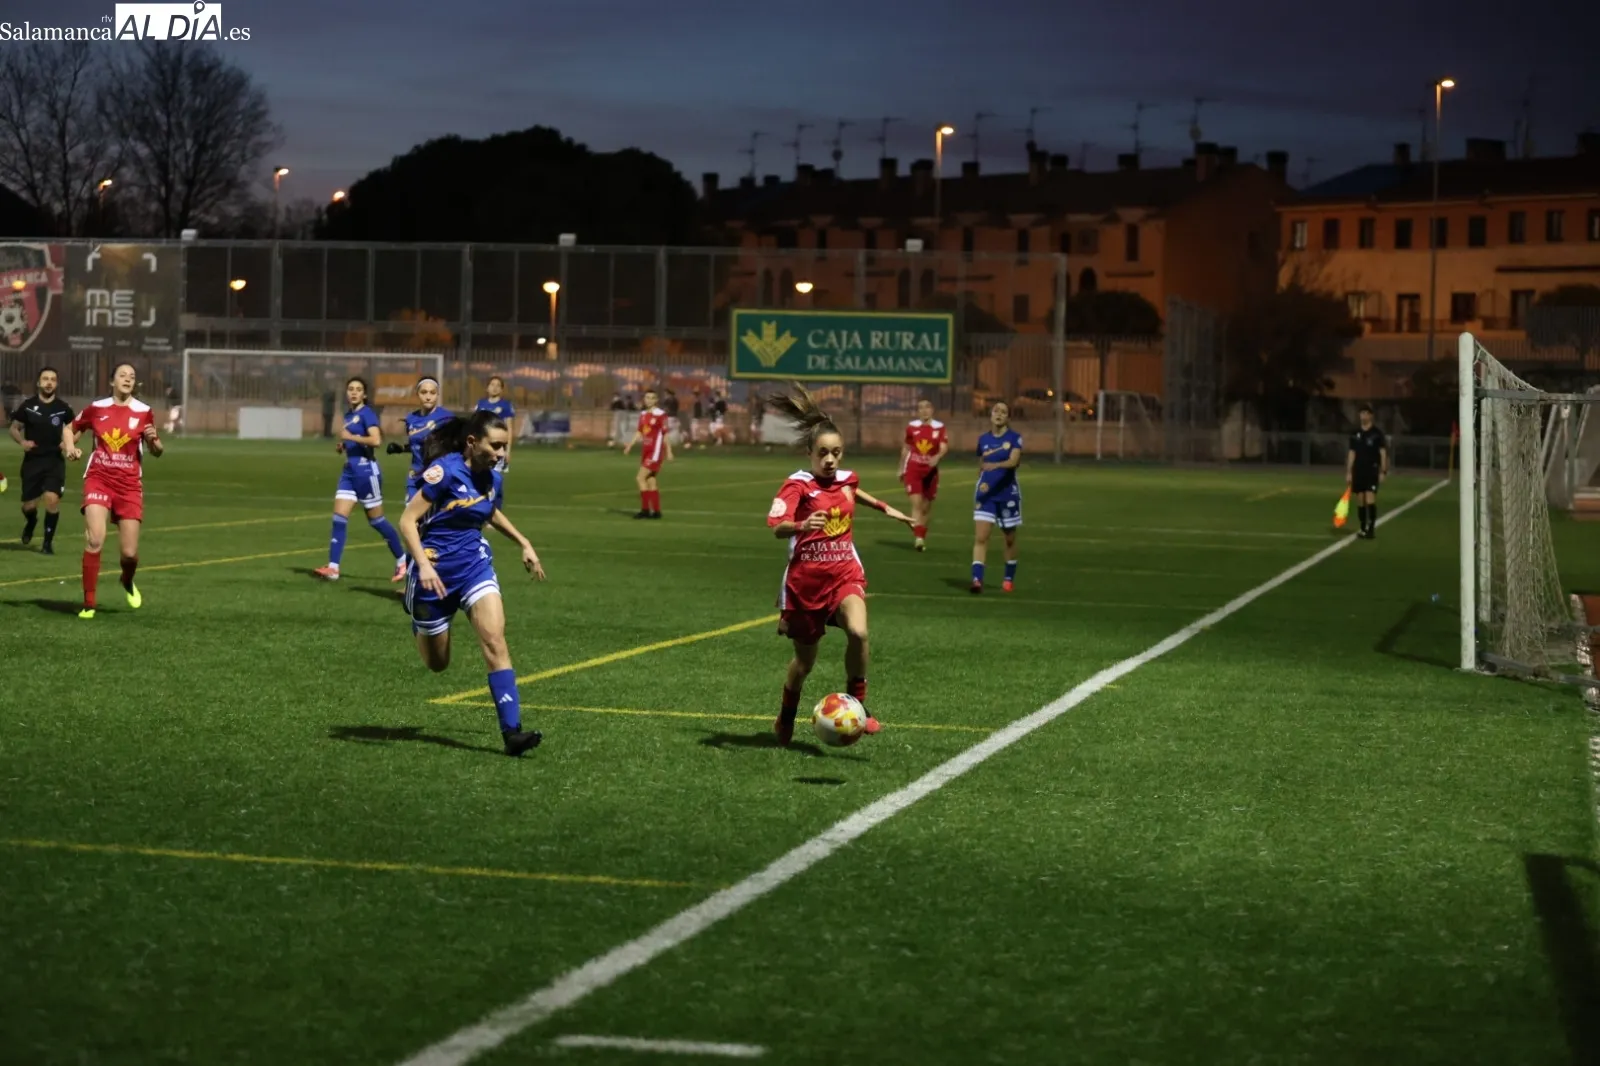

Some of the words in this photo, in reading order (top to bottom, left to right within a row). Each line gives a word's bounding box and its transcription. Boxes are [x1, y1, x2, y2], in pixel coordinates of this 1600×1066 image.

[806, 329, 864, 355] CAJA
[870, 330, 946, 352] RURAL
[807, 354, 831, 370] DE
[833, 353, 945, 373] SALAMANCA
[800, 553, 812, 561] DE
